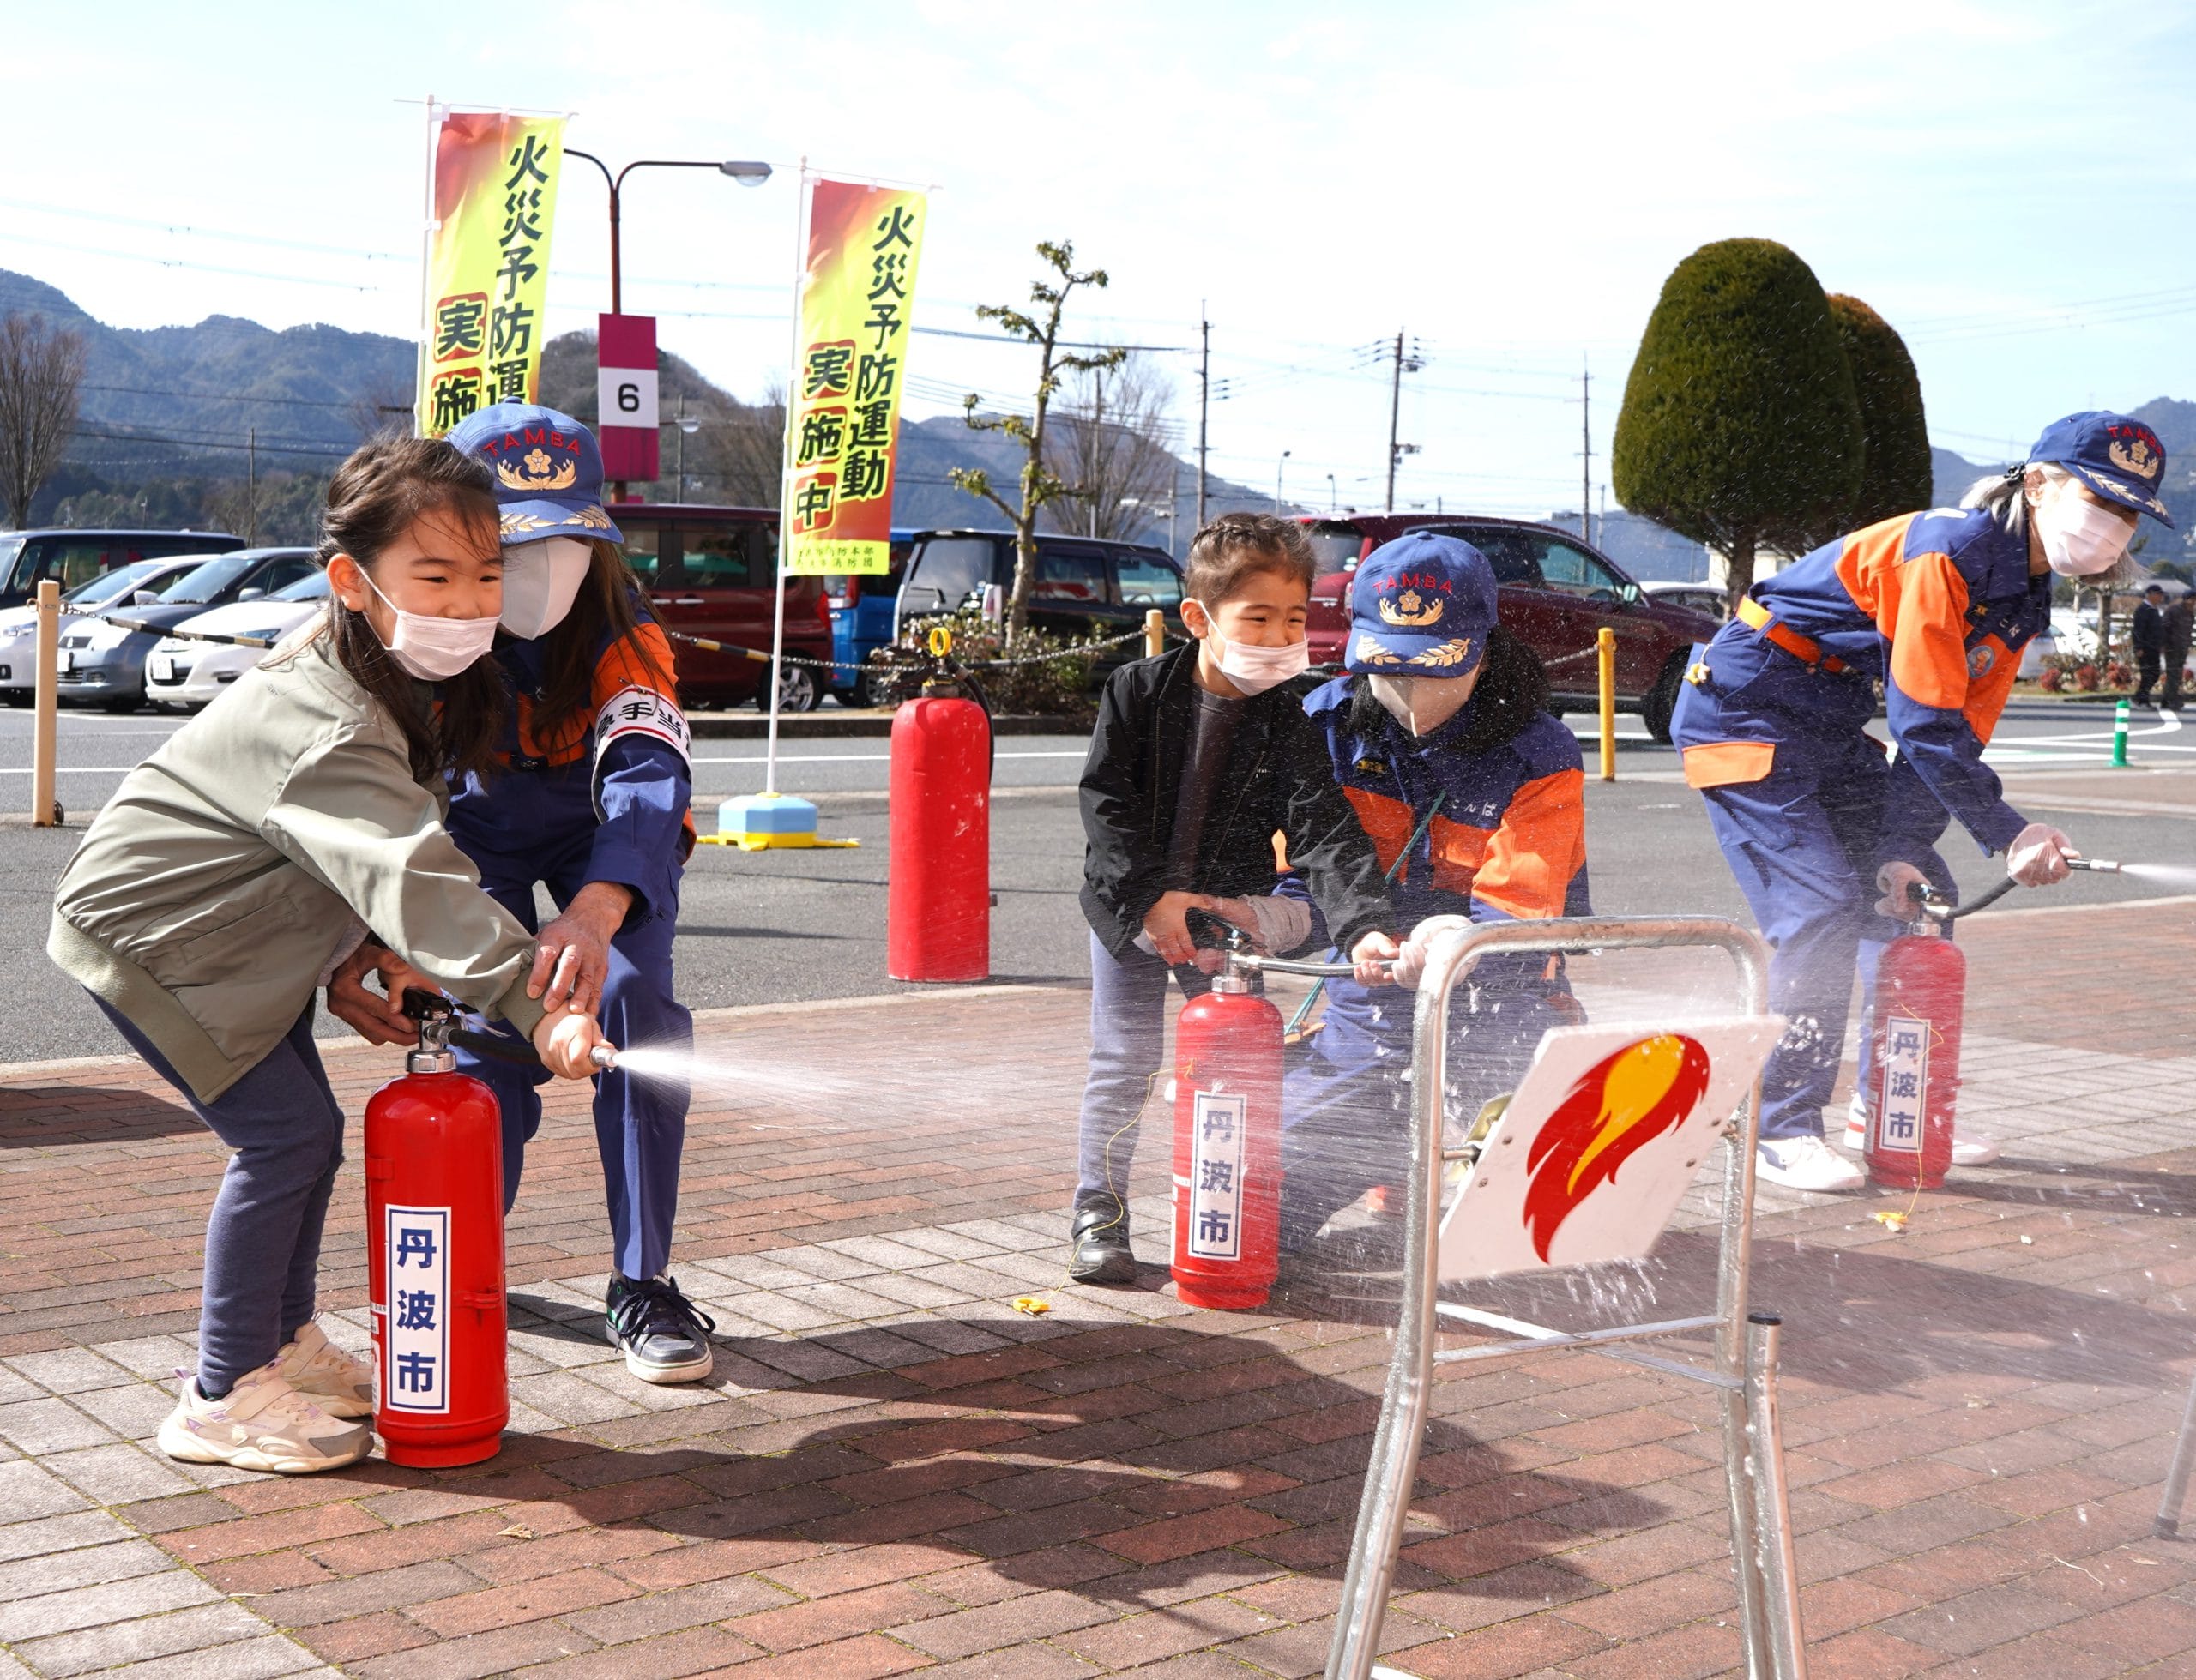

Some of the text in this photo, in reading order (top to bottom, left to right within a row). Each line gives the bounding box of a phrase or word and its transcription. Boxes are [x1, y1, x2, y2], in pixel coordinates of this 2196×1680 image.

[618, 382, 640, 412] 6
[840, 206, 914, 499] 火災予防運動
[483, 427, 582, 457] TAMBA
[796, 348, 851, 527] 実施中
[2107, 425, 2164, 457] TAMBA
[1372, 572, 1454, 596] TAMBA
[1889, 1032, 1921, 1138] 丹波市
[1199, 1110, 1235, 1243] 丹波市
[397, 1228, 437, 1393] 丹波市
